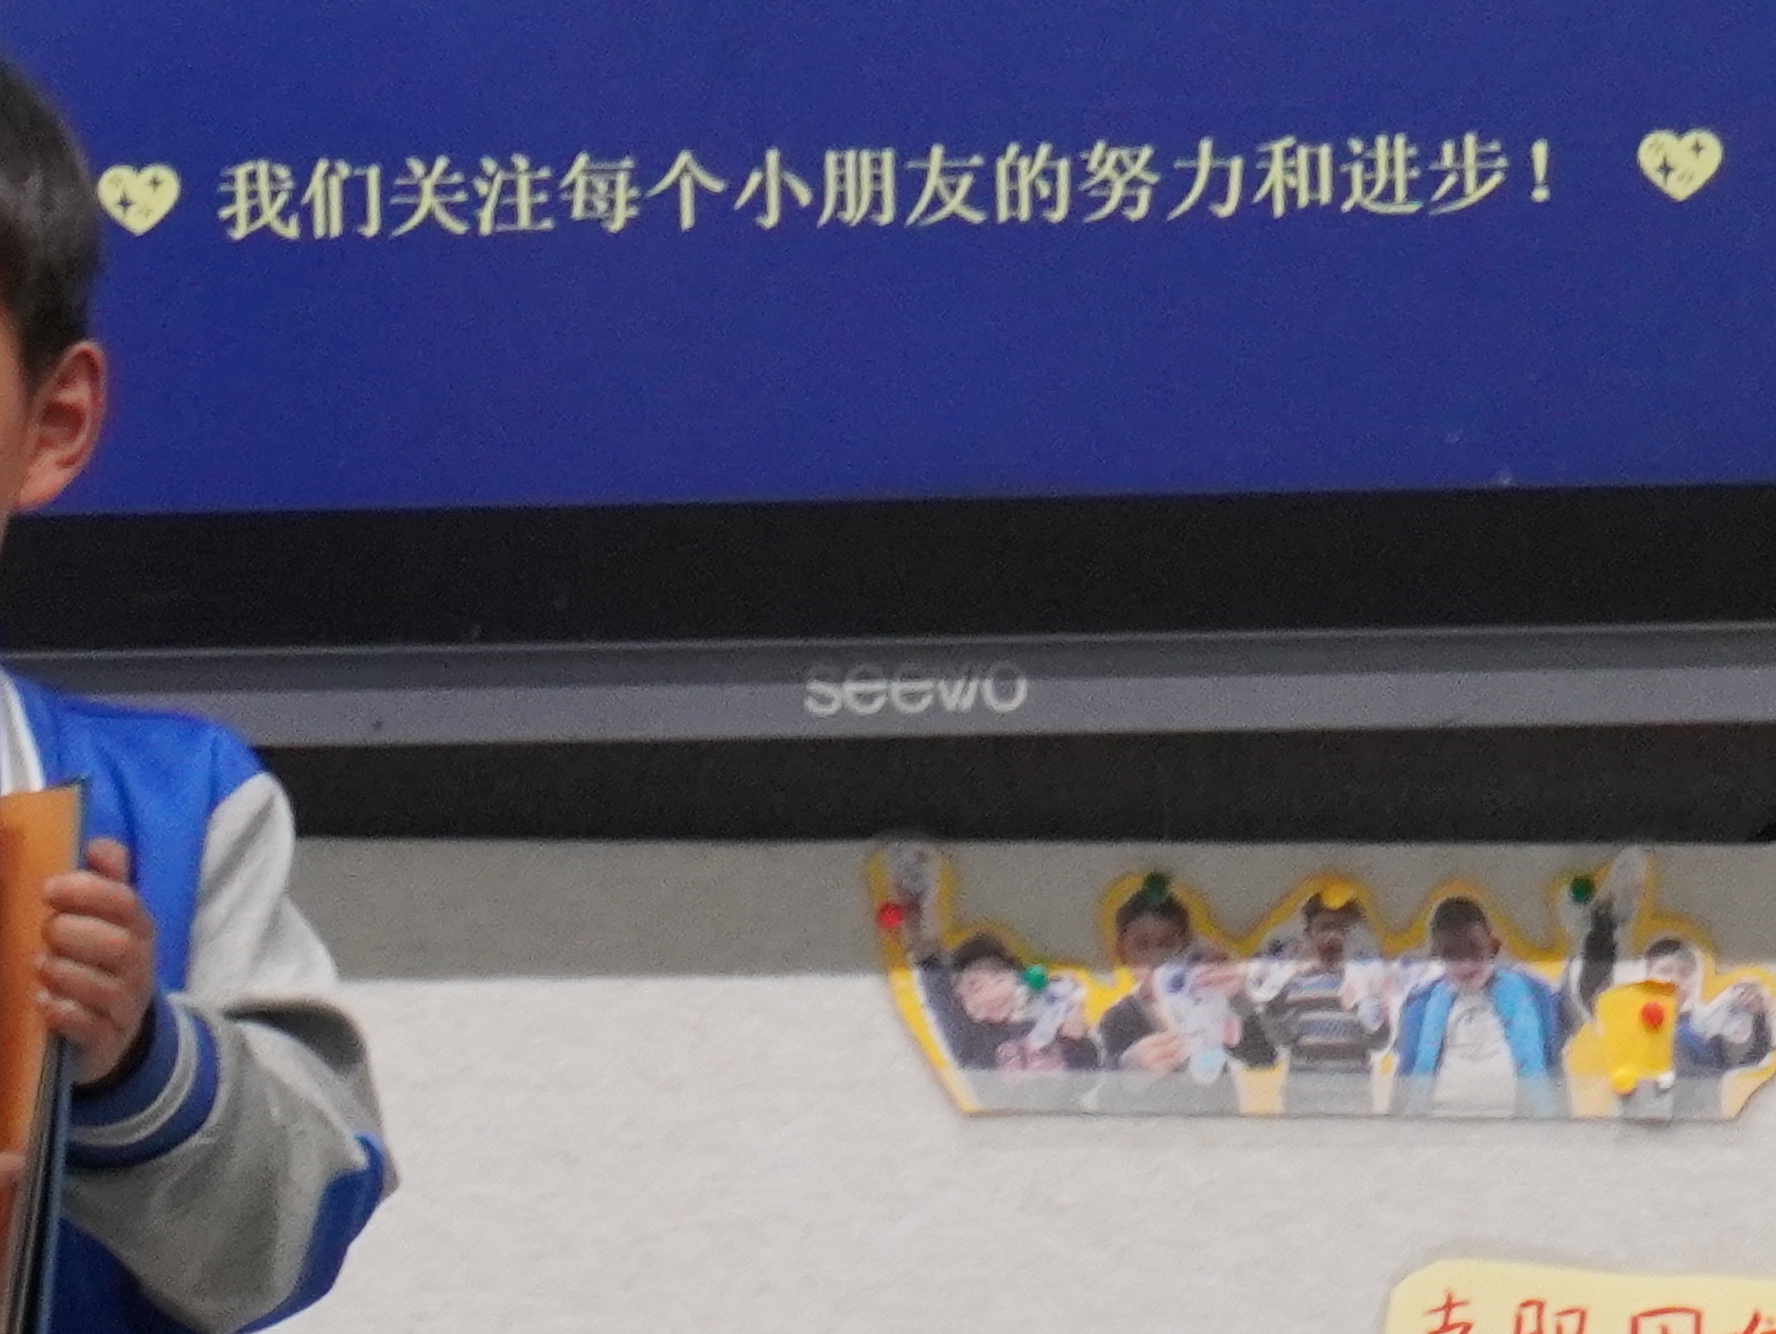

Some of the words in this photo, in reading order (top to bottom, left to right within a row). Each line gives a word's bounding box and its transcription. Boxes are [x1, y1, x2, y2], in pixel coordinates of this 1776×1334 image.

[217, 130, 1550, 242] 我们关注每个小朋友的努力和进步！
[804, 665, 1029, 716] seewo
